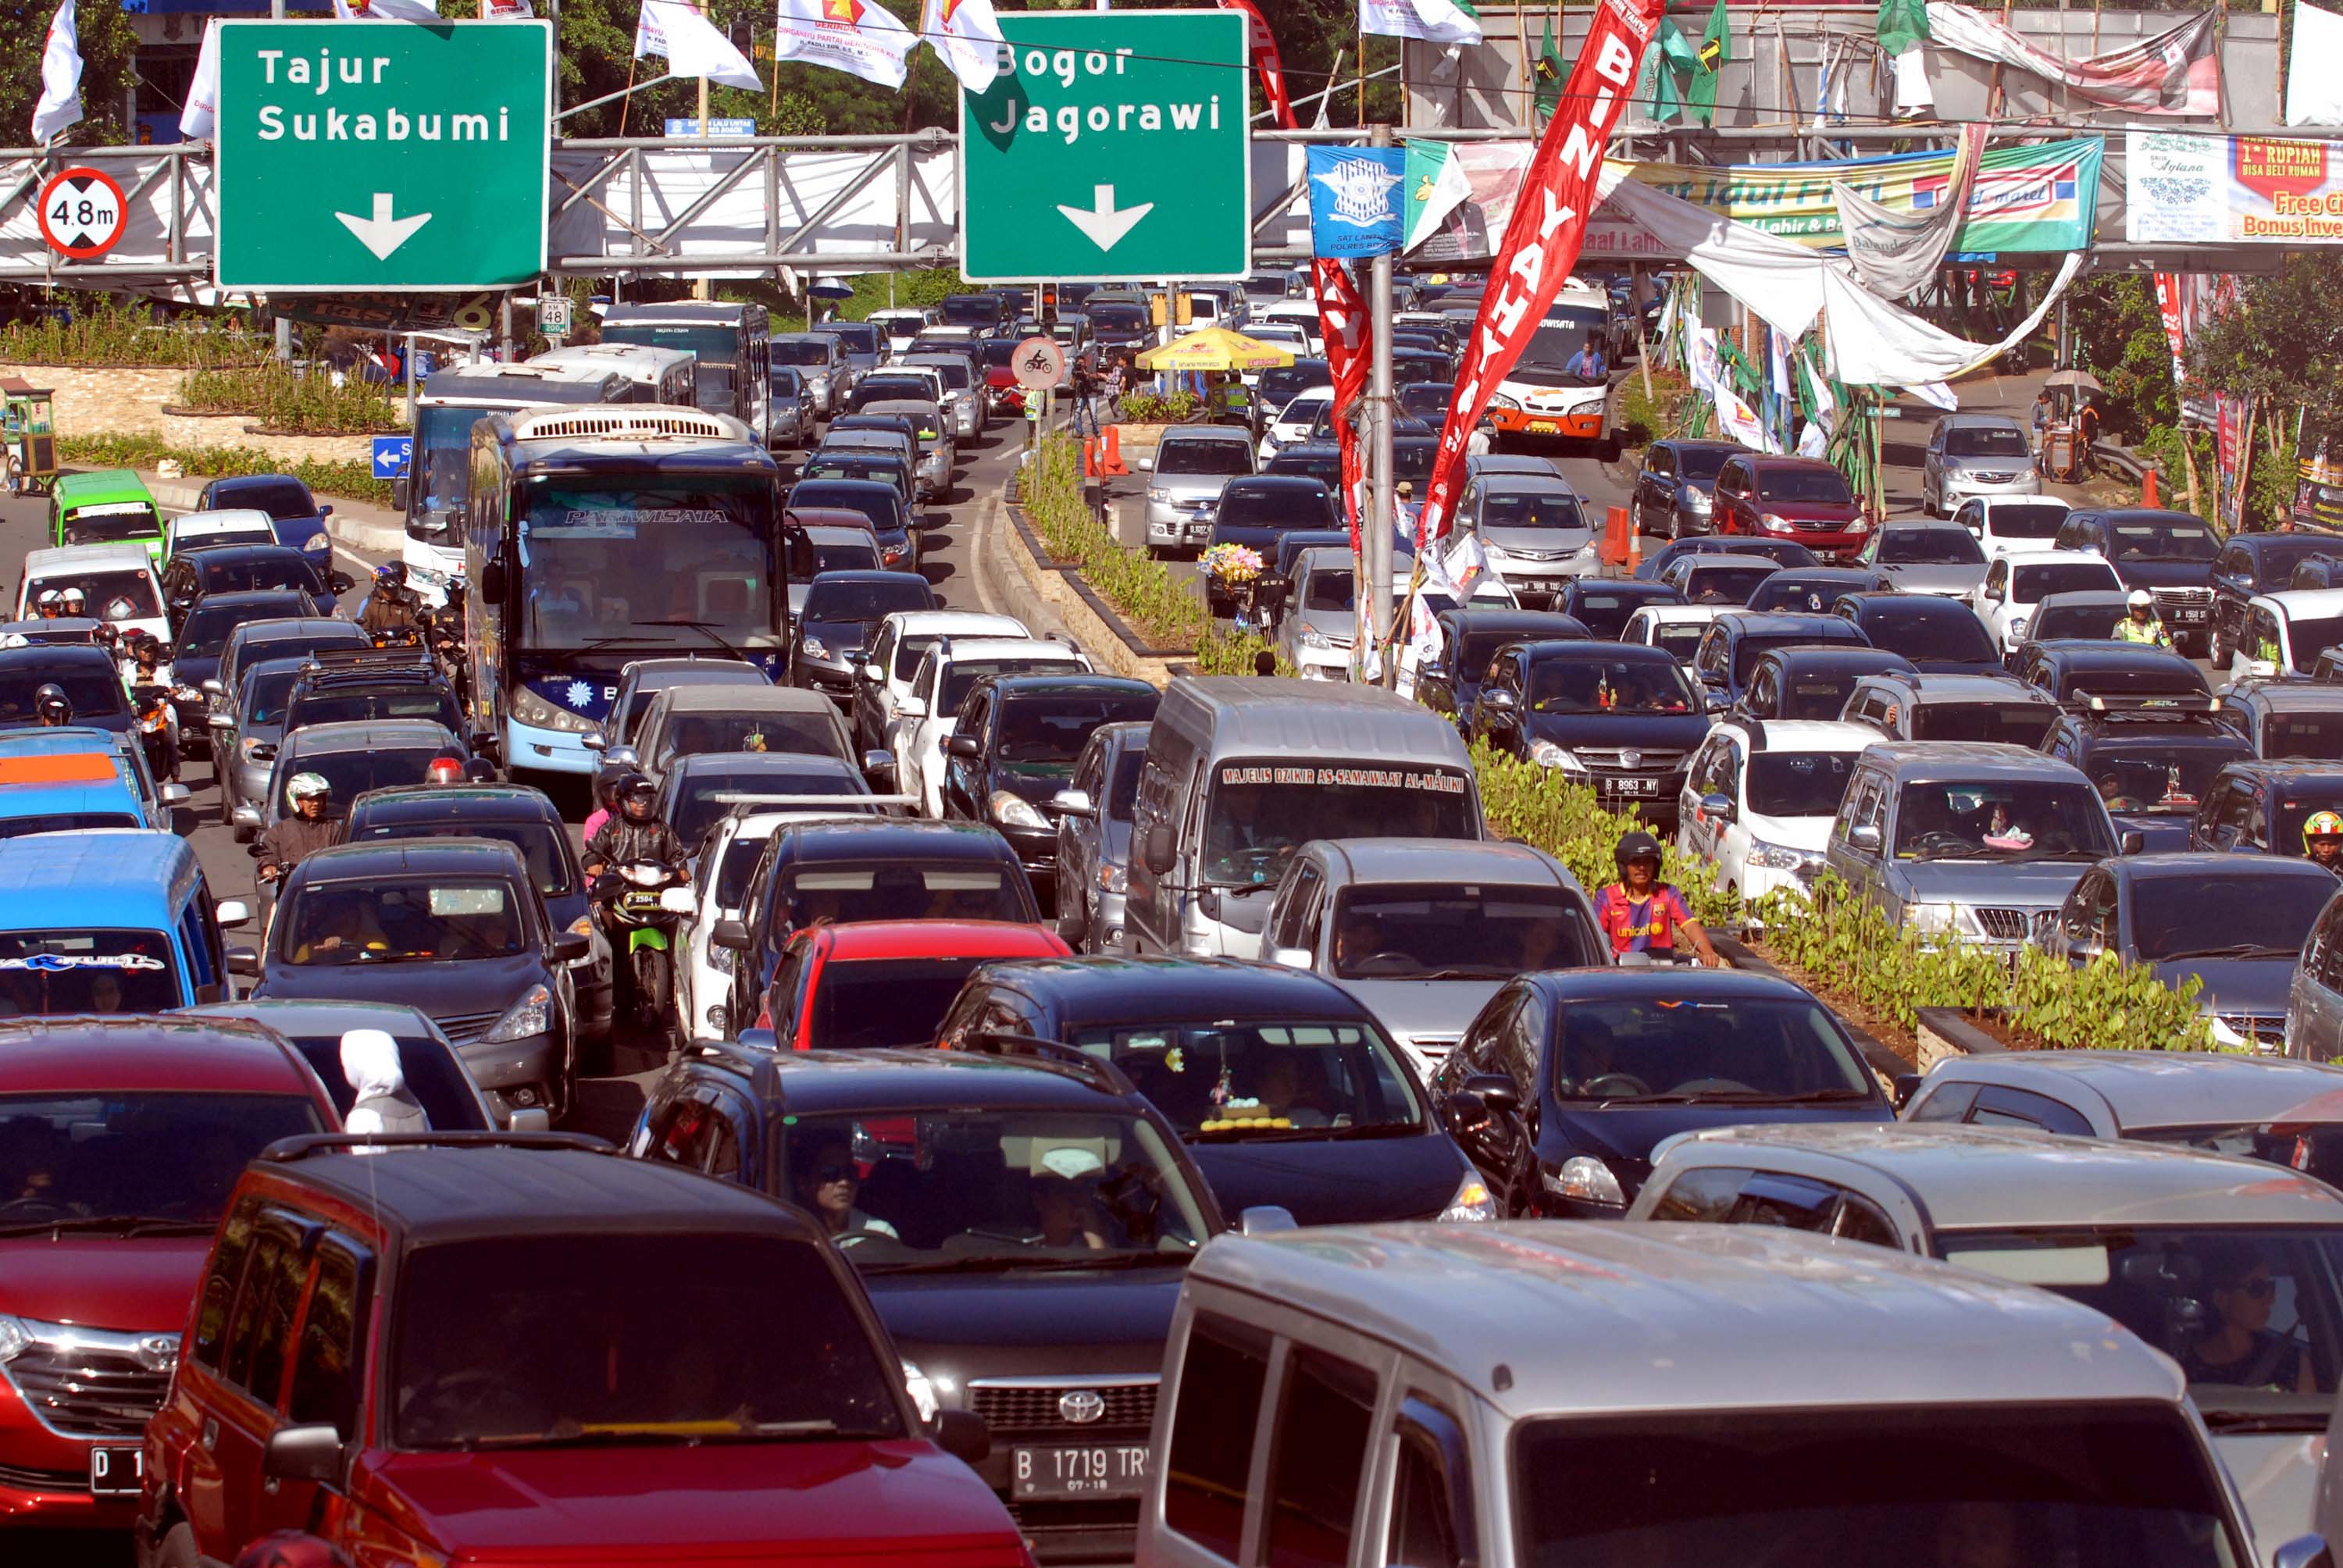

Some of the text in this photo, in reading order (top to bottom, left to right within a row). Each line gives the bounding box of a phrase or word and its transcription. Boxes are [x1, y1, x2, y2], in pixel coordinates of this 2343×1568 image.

[258, 48, 390, 95] Tajur
[996, 44, 1134, 87] Bogor
[1560, 31, 1633, 181] BIN
[258, 106, 509, 142] Sukabumi
[990, 94, 1220, 145] Jagorawi
[2266, 146, 2321, 164] RUPIAH
[2242, 164, 2320, 177] BISA BELI RUMAH
[1703, 179, 1788, 206] Idul
[2273, 191, 2323, 215] Free
[1760, 219, 1806, 233] Lahir
[2242, 214, 2303, 236] Bonus
[545, 311, 563, 323] 48
[545, 324, 562, 333] 200
[565, 509, 729, 524] PARIWISATA
[1222, 768, 1273, 785] MAJELIS
[1275, 768, 1315, 786] DZIKIR
[1317, 768, 1403, 788] AS-SAMAWAAT
[1617, 779, 1639, 791] 8963
[1617, 925, 1650, 938] unicef
[95, 1451, 109, 1477] D
[1018, 1449, 1032, 1480] B
[1054, 1449, 1107, 1479] 1719
